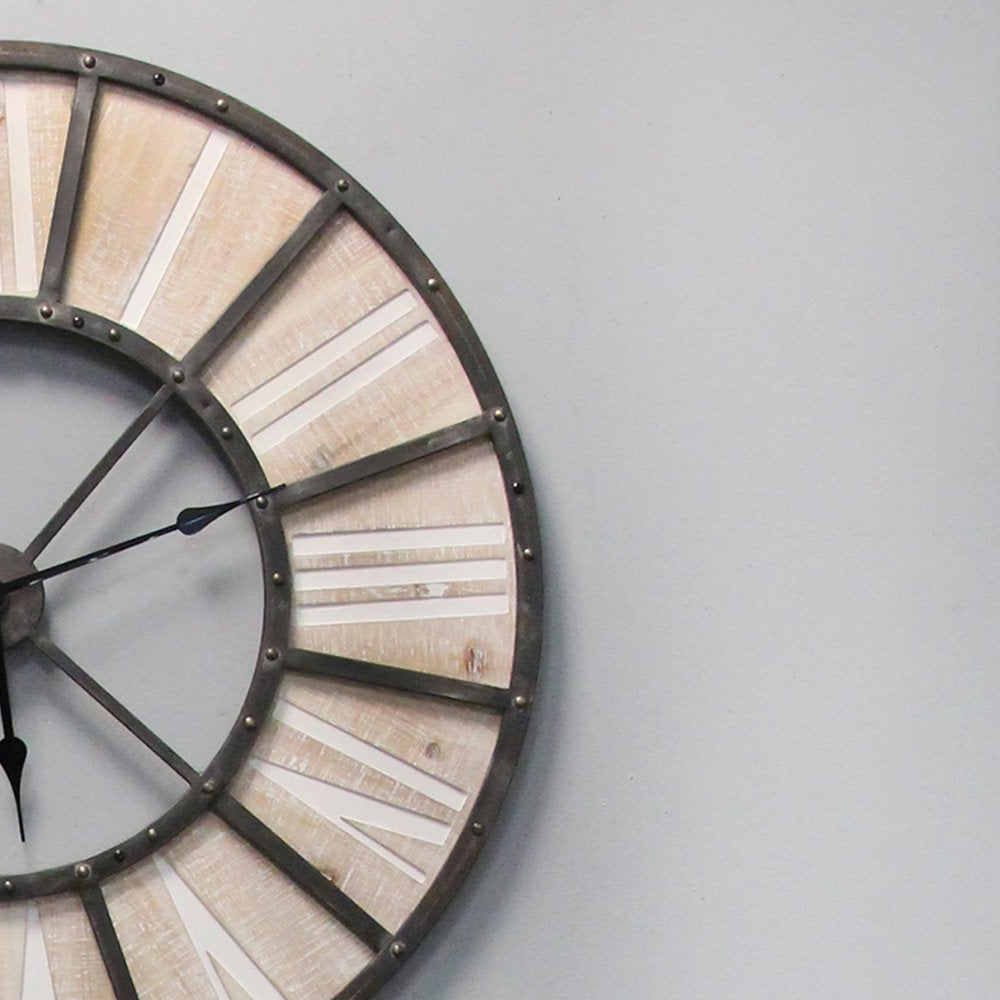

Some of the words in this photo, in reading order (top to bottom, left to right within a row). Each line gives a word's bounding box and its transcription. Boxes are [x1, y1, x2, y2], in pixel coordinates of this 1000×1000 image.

[119, 128, 230, 330] I
[231, 289, 440, 453] II
[292, 523, 510, 626] III
[249, 700, 469, 883] IV
